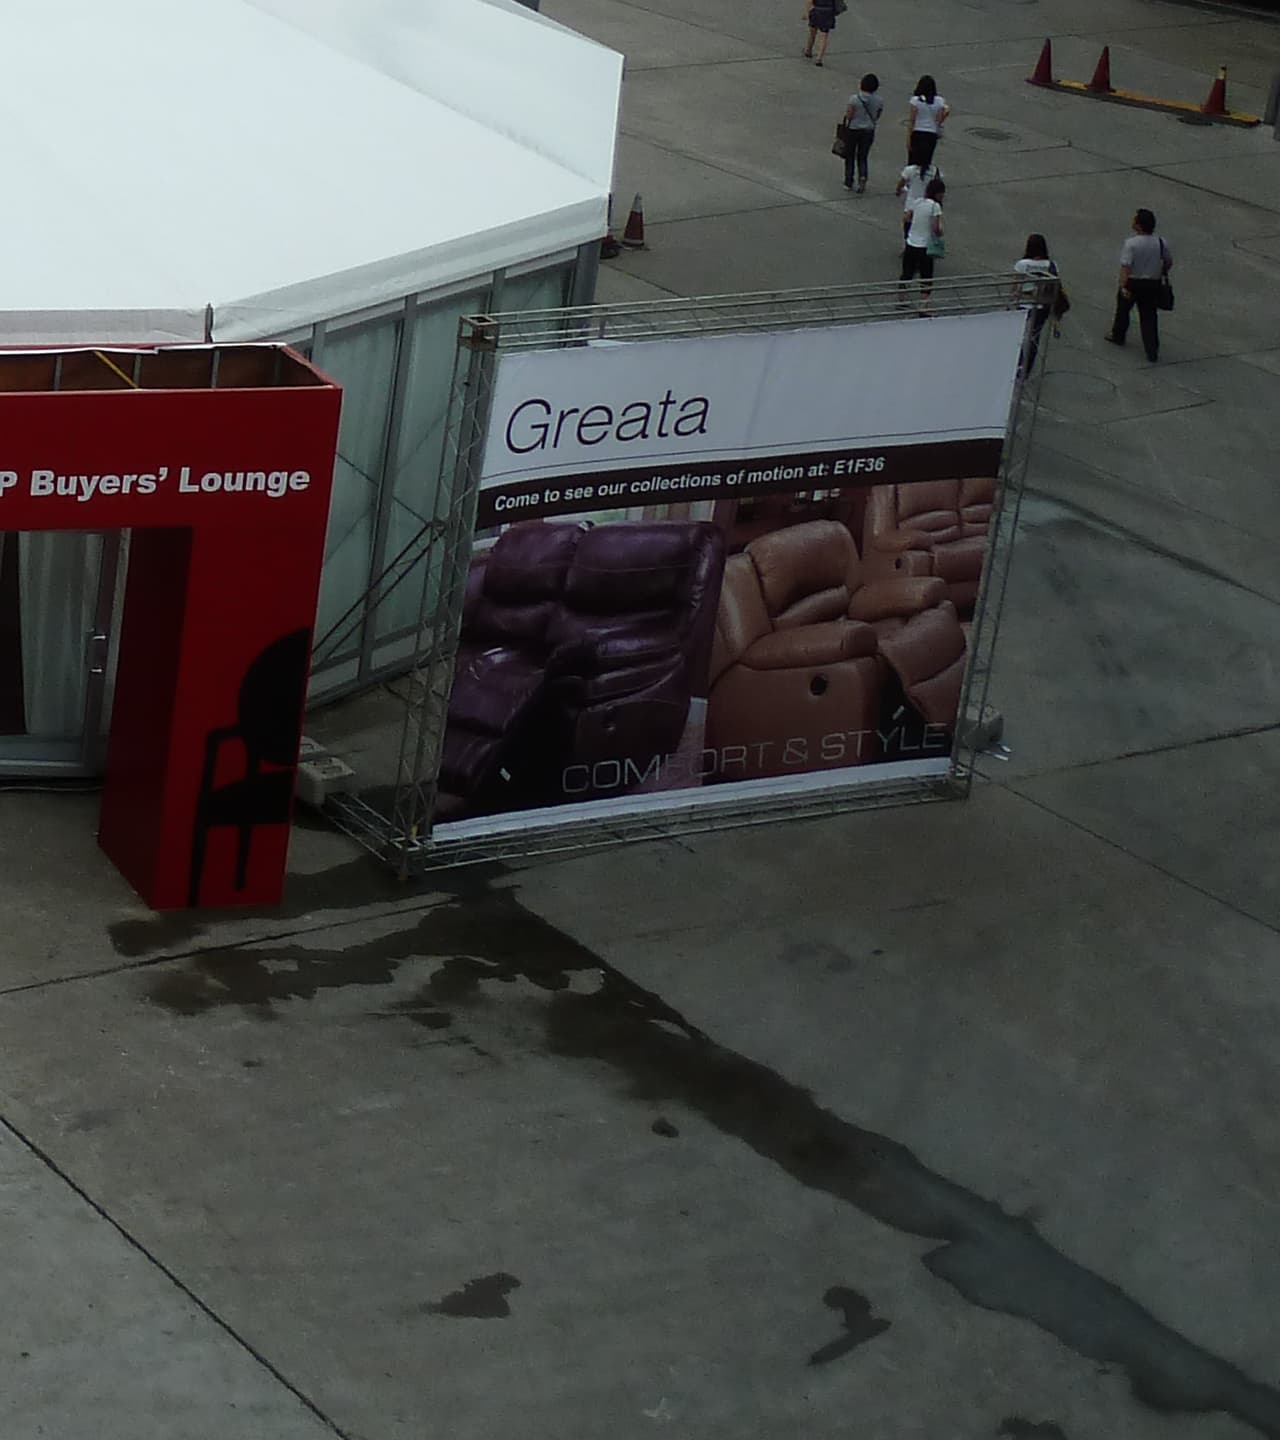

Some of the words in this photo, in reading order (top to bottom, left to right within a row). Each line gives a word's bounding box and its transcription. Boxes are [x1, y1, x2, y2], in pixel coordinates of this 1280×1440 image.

[505, 389, 711, 455] Greata
[30, 466, 170, 502] Buyers'
[178, 465, 312, 498] Lounge
[494, 490, 540, 512] Come
[543, 486, 561, 504] to
[563, 485, 594, 502] see
[597, 482, 626, 497] our
[629, 471, 722, 495] collections
[726, 468, 745, 486] of
[746, 462, 804, 485] motion
[807, 461, 830, 478] at:
[833, 456, 886, 475] E1F36
[562, 741, 776, 794] COMFORT
[782, 737, 809, 765] &
[820, 722, 948, 759] STYLE
